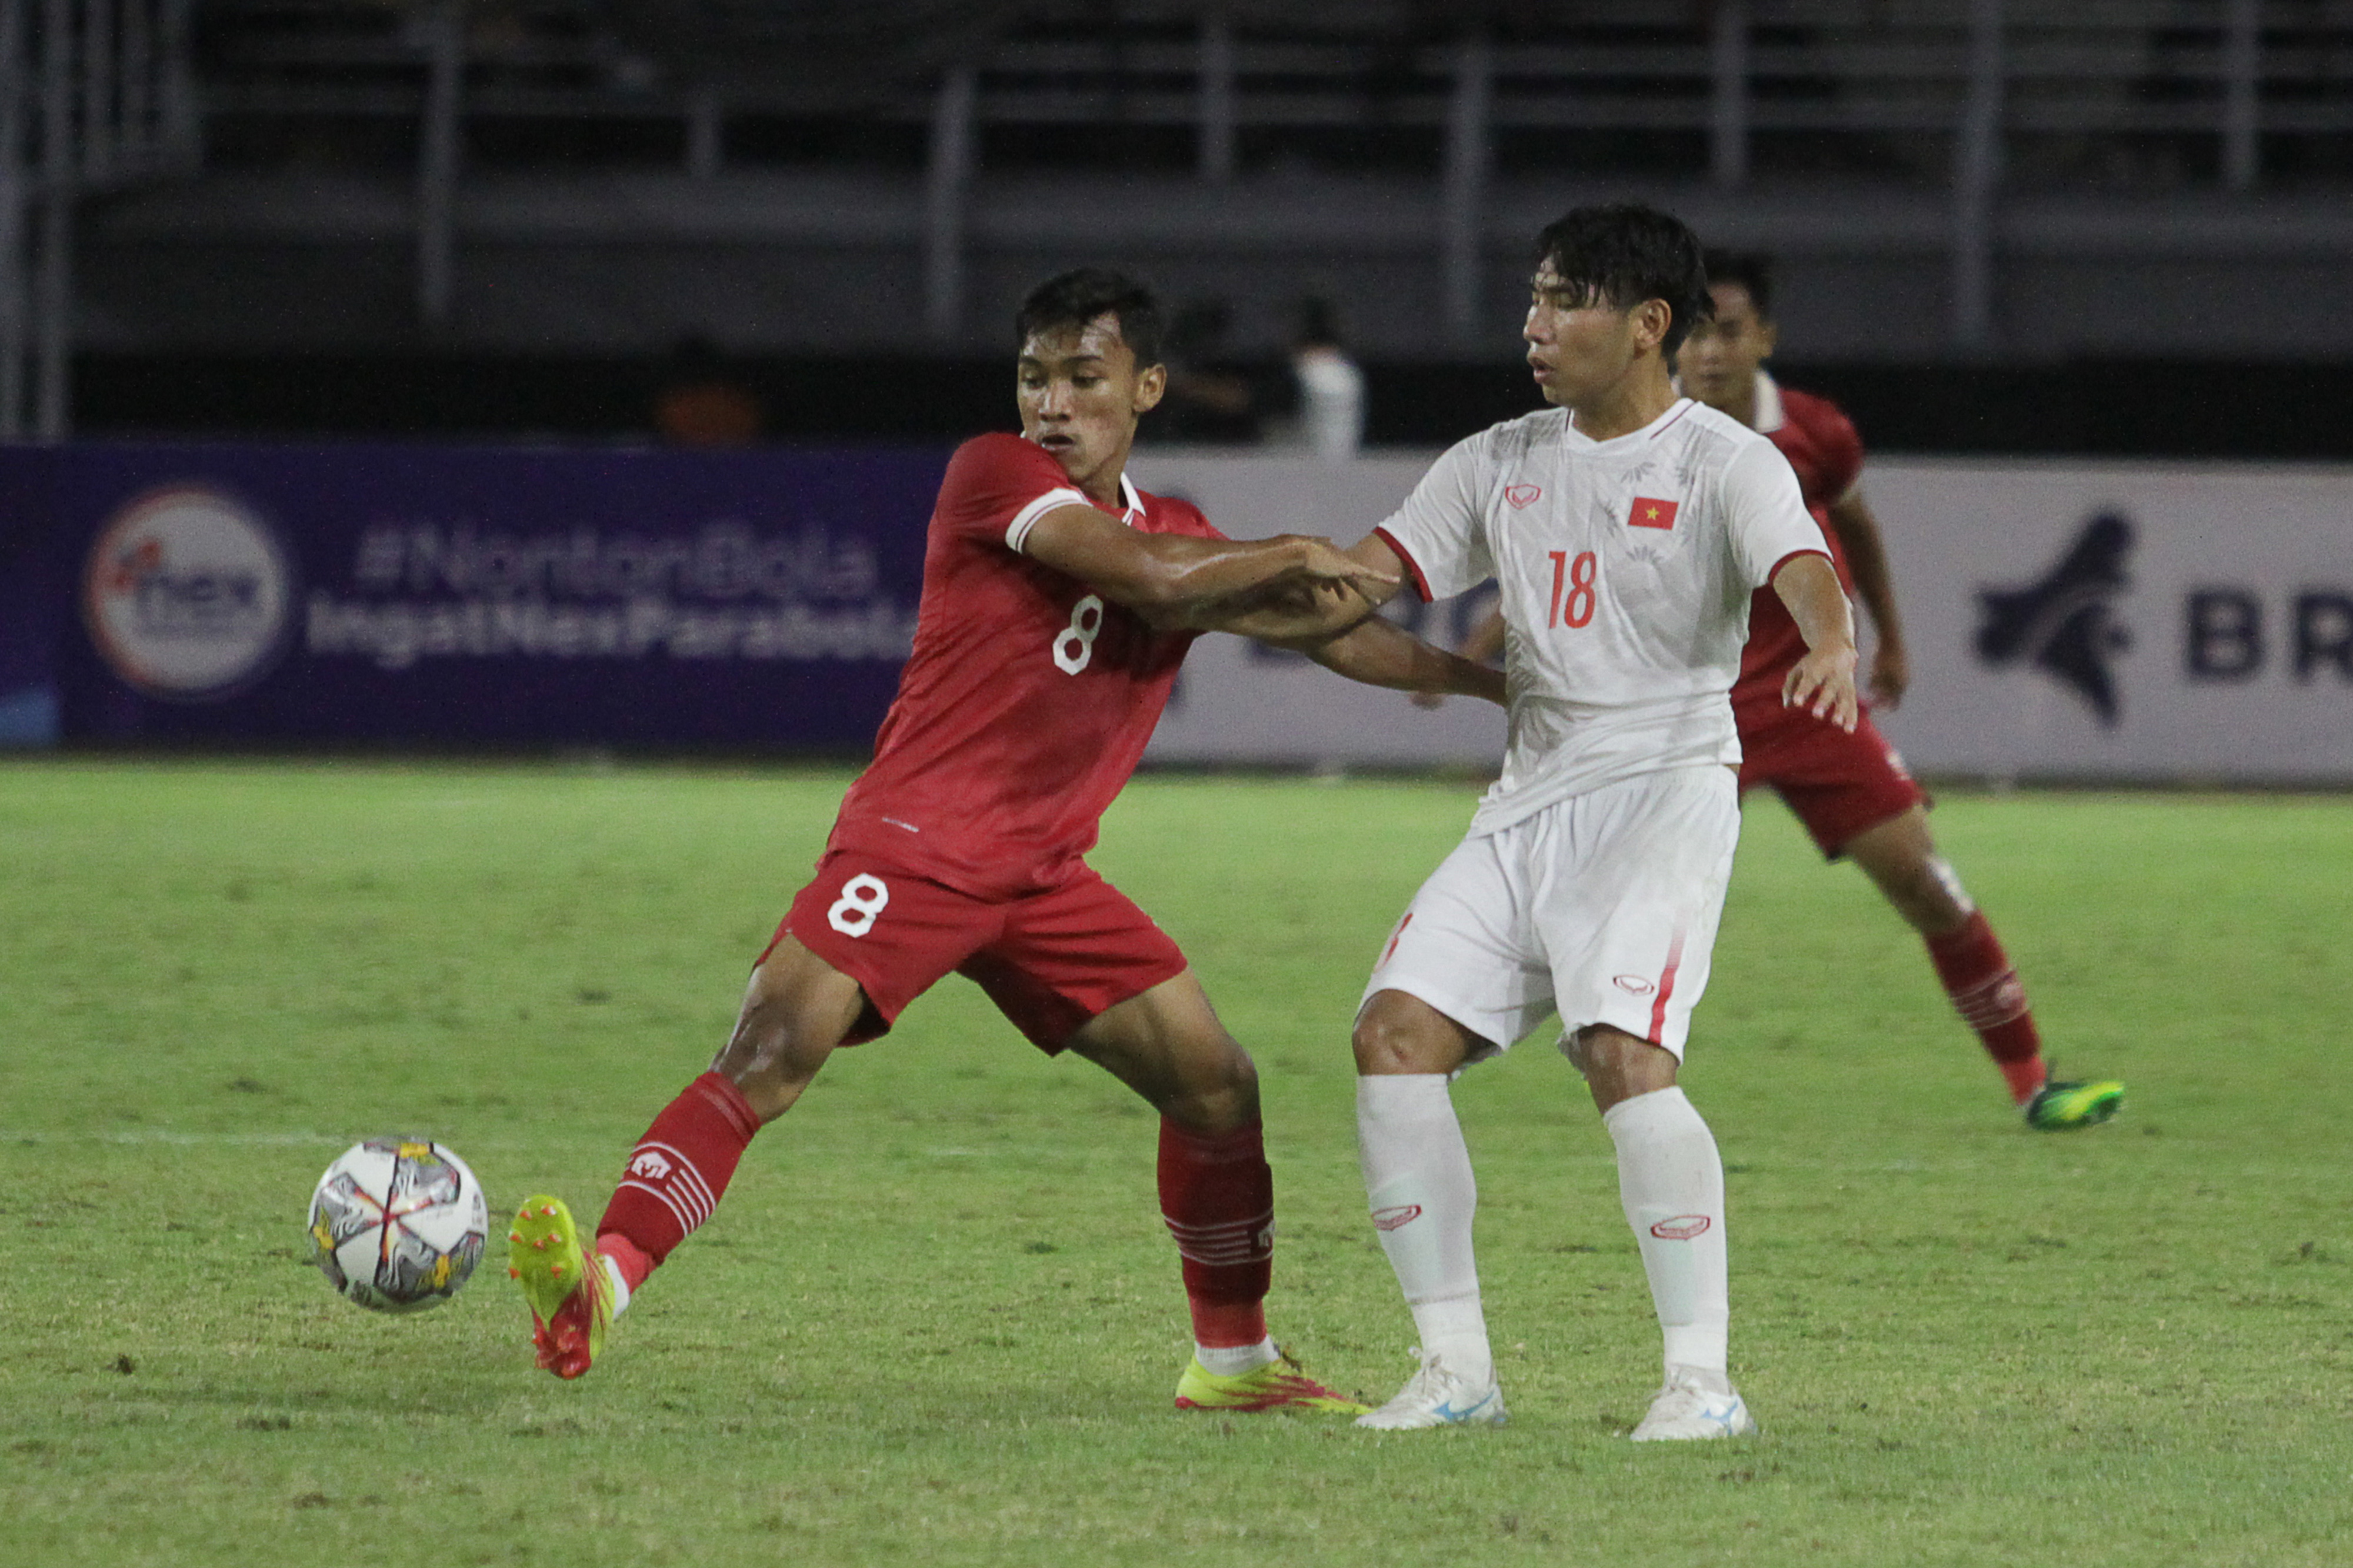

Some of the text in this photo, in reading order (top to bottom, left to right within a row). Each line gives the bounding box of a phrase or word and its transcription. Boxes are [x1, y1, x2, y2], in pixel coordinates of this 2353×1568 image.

[1548, 551, 1597, 629] 18
[1052, 594, 1104, 676] 8
[2187, 588, 2353, 685] BR
[827, 872, 889, 938] 8
